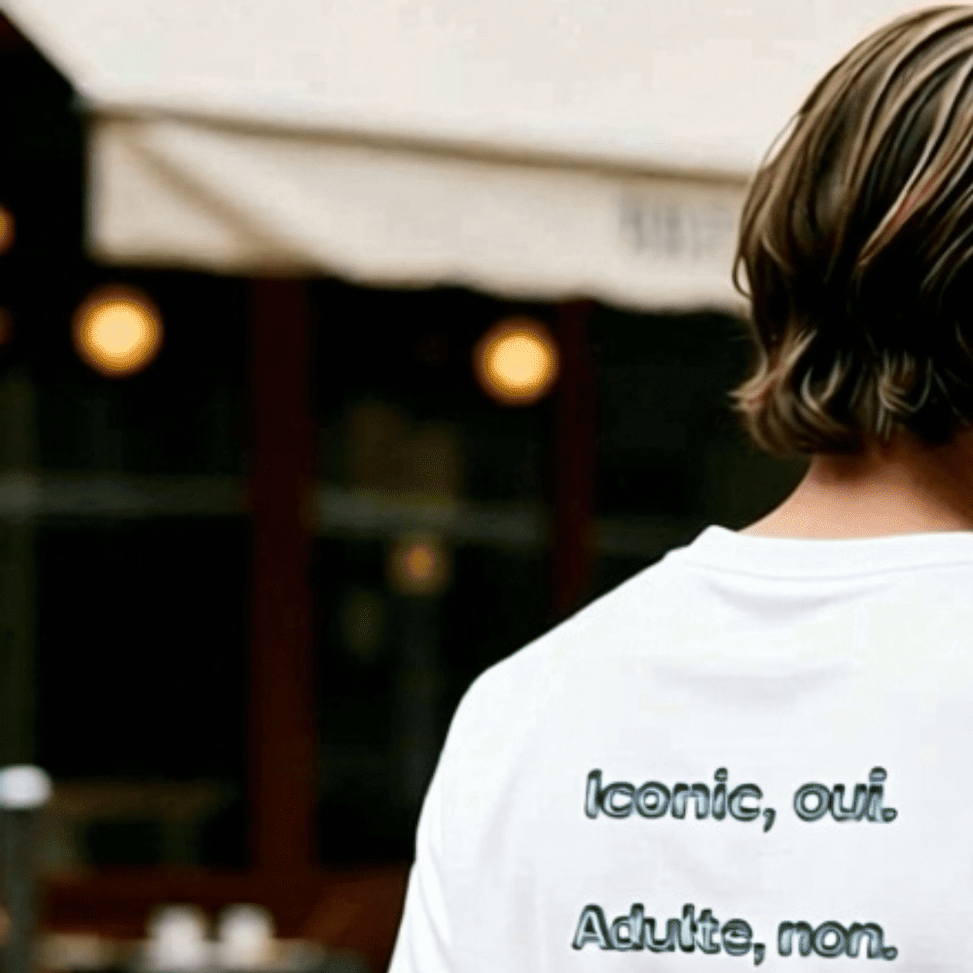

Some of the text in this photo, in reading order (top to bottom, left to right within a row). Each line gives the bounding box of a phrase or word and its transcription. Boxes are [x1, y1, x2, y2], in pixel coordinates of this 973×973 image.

[585, 766, 898, 833] Iconic, oui.
[572, 903, 899, 966] Adulte, non.
